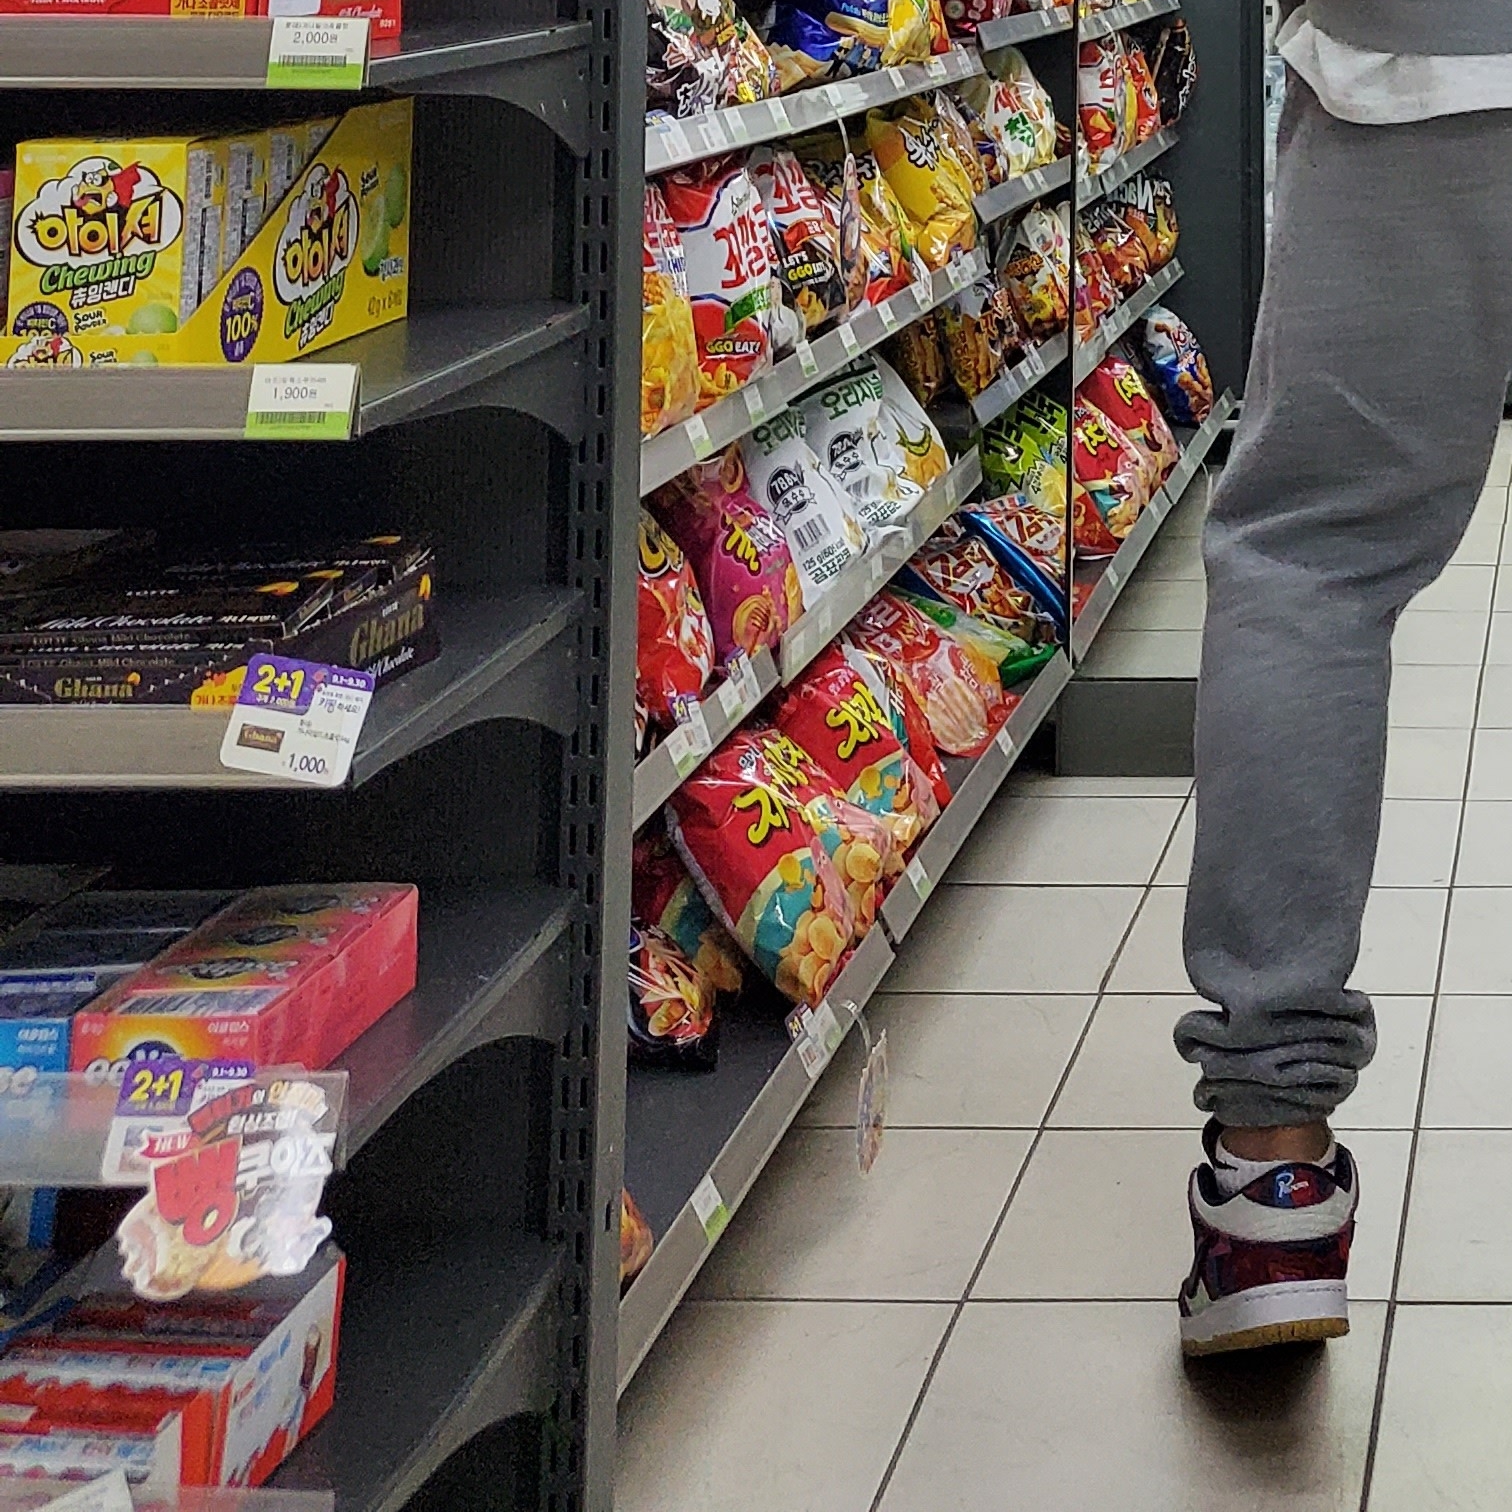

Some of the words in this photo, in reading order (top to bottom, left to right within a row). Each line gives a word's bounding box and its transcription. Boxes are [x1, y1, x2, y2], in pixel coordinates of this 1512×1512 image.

[293, 31, 340, 46] 2,000원
[32, 191, 165, 257] 아이셔
[40, 249, 156, 296] Chewing
[73, 310, 104, 324] SOUR
[284, 272, 346, 339] Chewing
[225, 311, 259, 345] 100%
[706, 340, 733, 355] GGO
[272, 385, 319, 401] 1,900원
[347, 603, 427, 668] Ghana
[54, 676, 136, 701] Ghana
[253, 664, 306, 698] 2+1
[130, 1069, 186, 1103] 2+1
[152, 1133, 191, 1155] NEW
